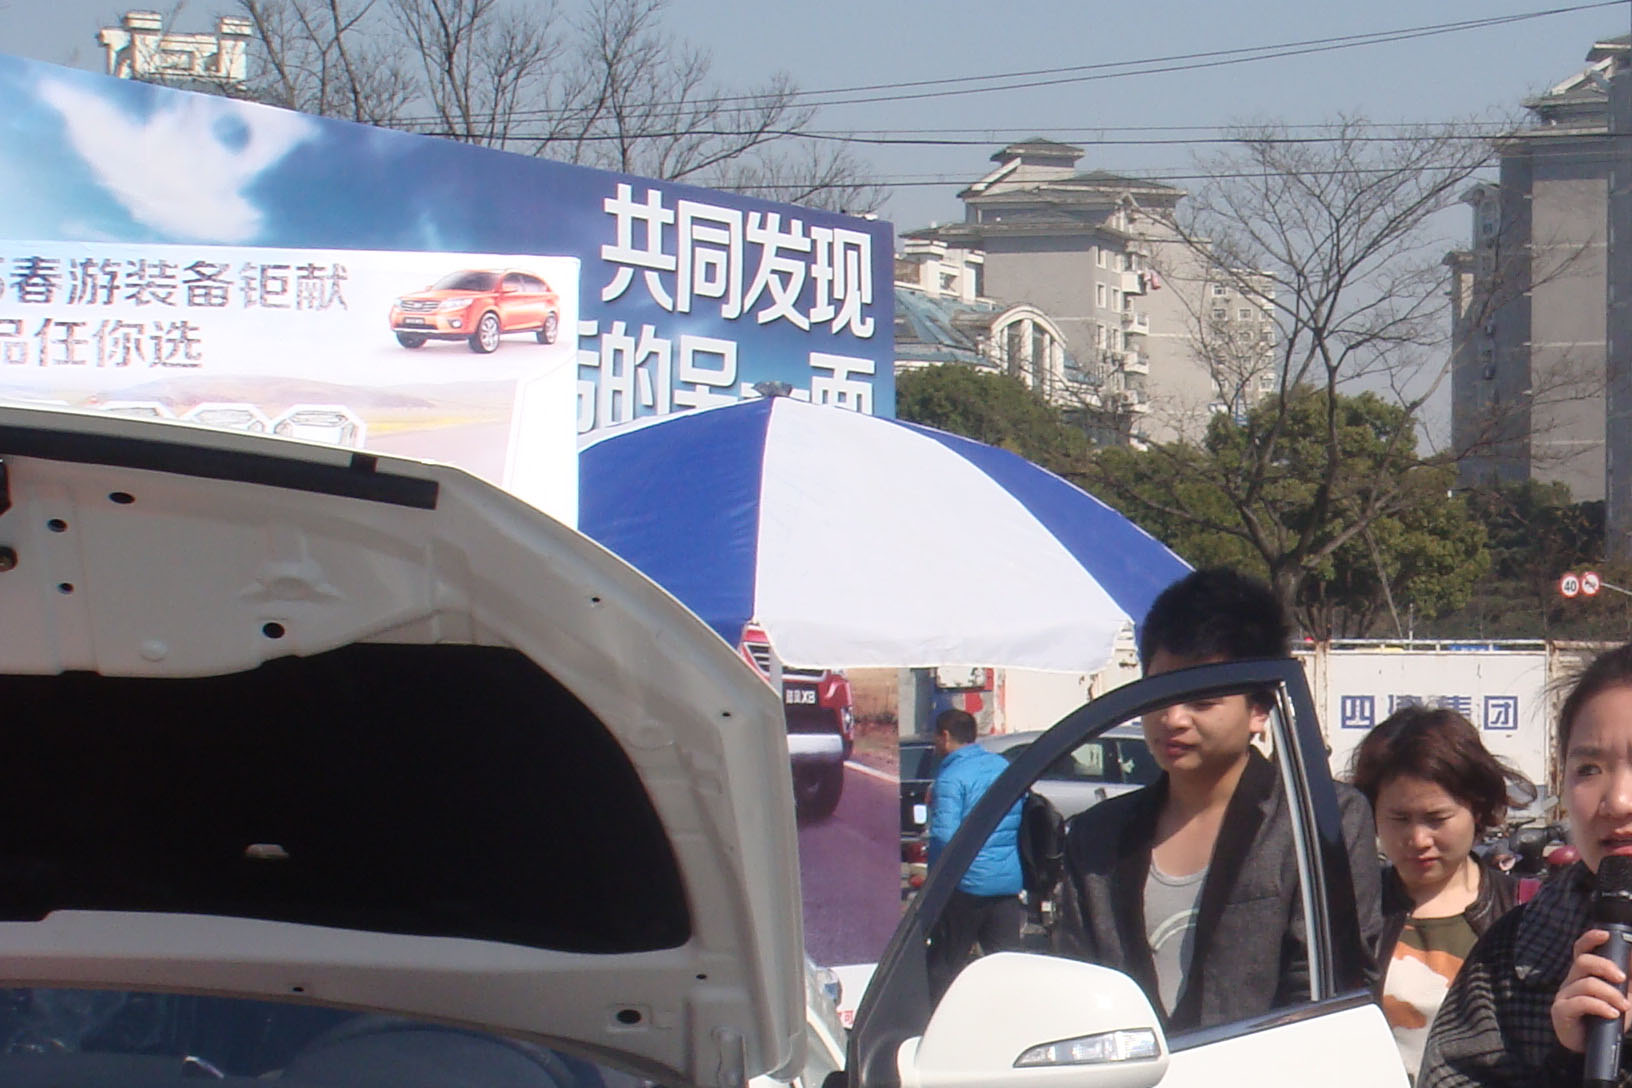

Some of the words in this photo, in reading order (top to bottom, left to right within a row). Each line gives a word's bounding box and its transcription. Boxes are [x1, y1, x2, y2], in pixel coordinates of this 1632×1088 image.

[601, 183, 875, 338] 共同发现
[577, 320, 875, 434] 的另一面
[1563, 580, 1577, 592] 40
